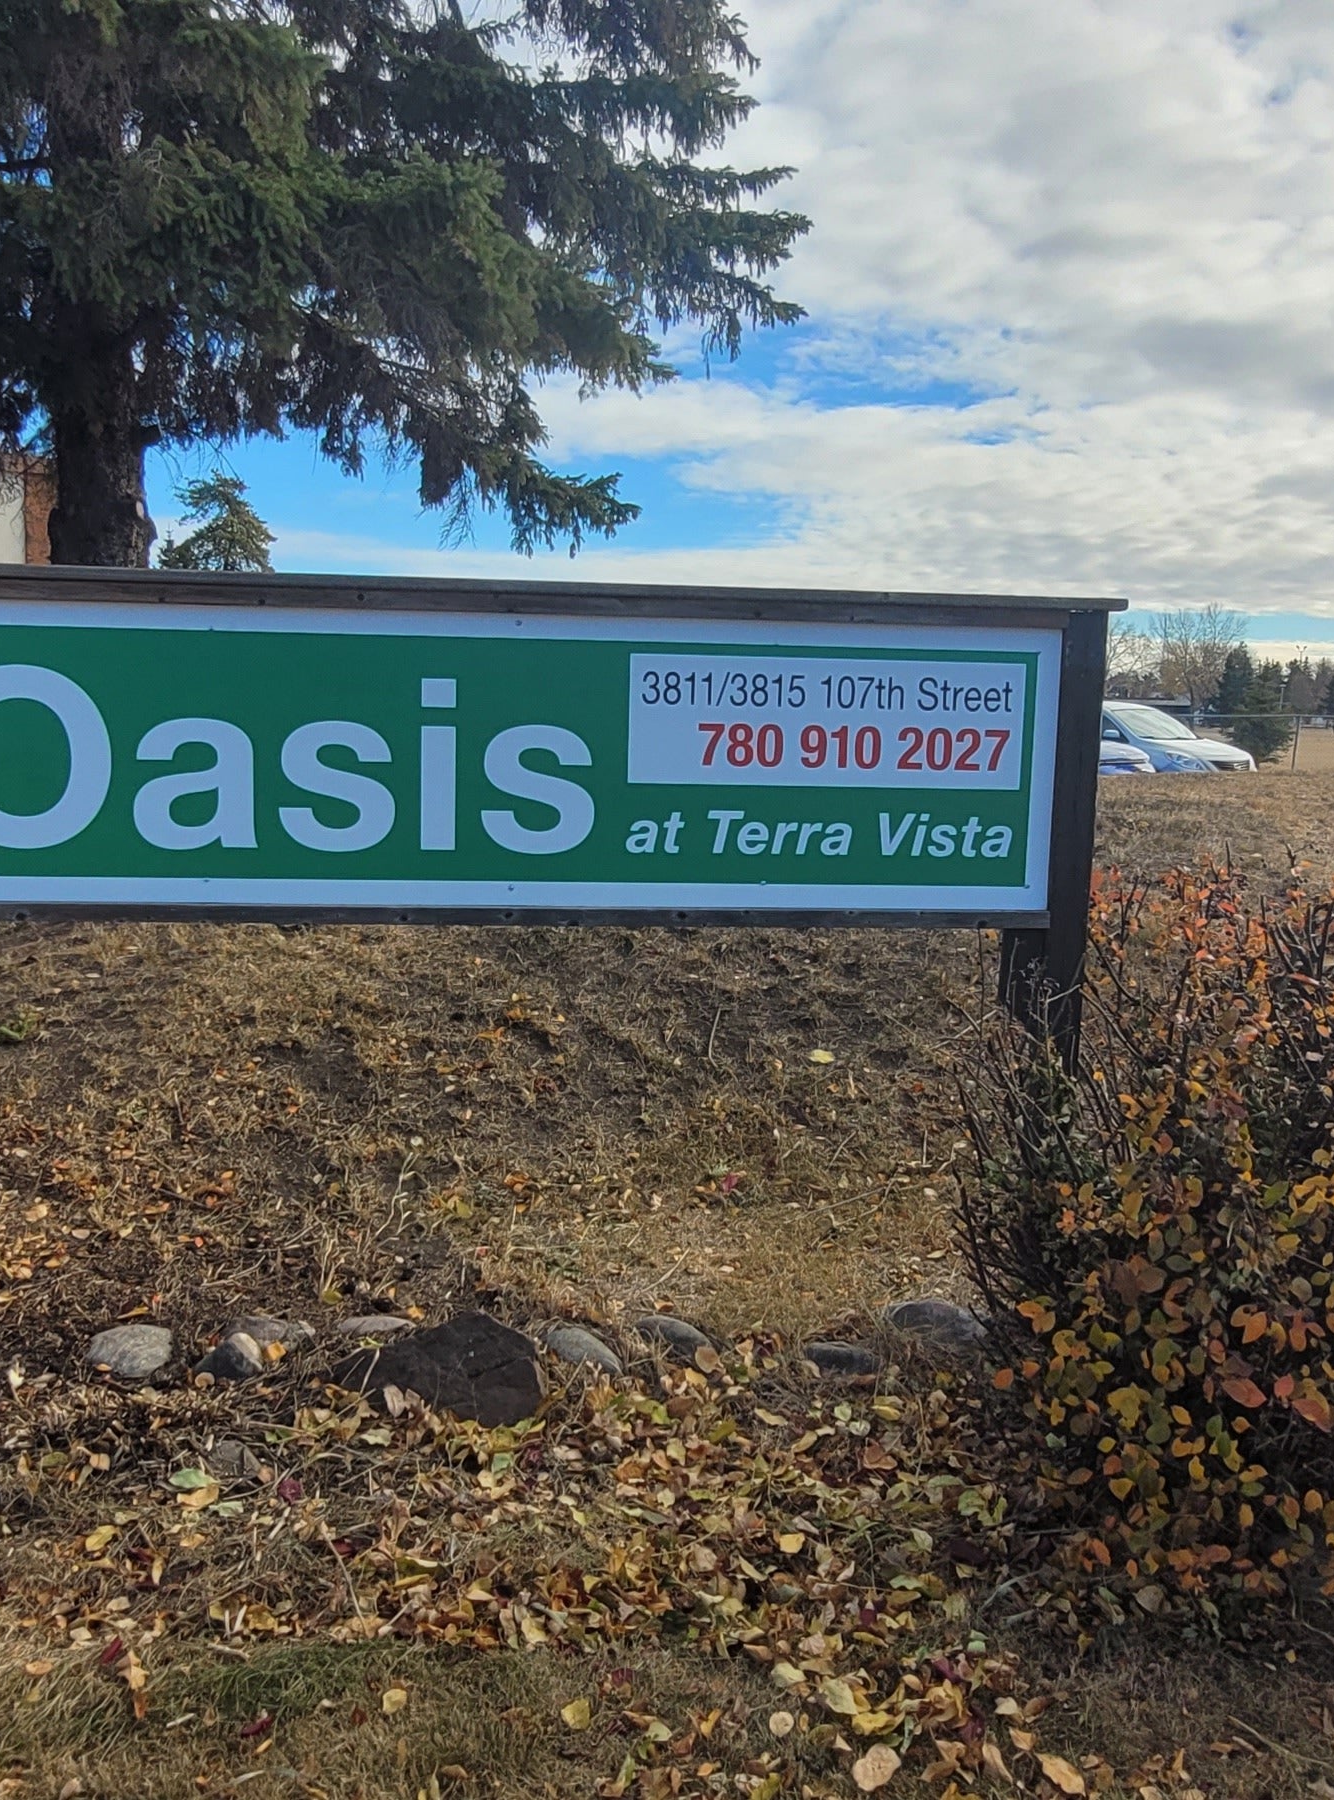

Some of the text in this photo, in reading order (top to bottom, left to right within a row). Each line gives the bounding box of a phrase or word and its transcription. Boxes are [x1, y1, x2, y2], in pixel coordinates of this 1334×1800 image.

[641, 671, 1013, 713] 3811/3815 107th Street
[697, 723, 1011, 772] 780 910 2027
[625, 810, 1013, 858] at Terra Vista
